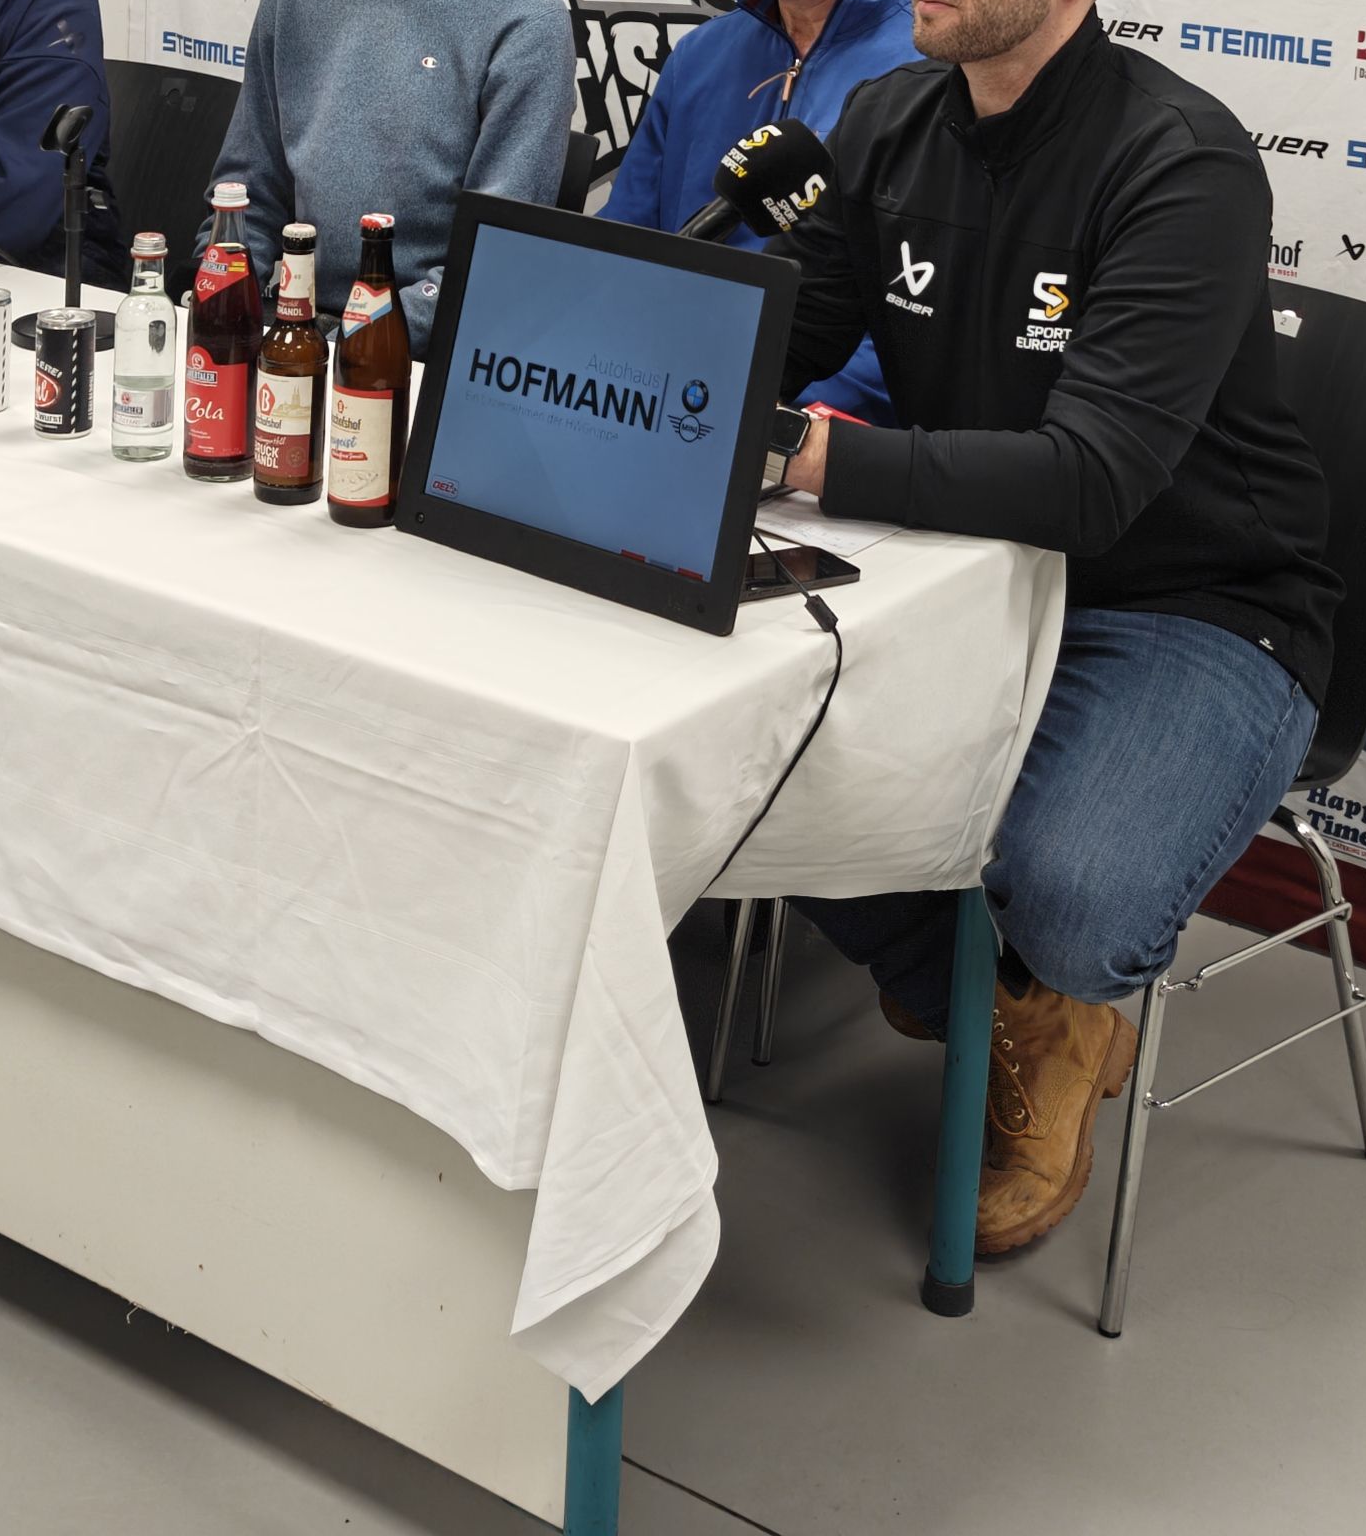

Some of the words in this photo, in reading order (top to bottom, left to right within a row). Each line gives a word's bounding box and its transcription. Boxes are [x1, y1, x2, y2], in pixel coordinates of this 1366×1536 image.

[163, 31, 246, 65] STEMMLE
[1181, 23, 1332, 67] STEMMLE
[197, 279, 216, 292] Cola
[1027, 325, 1072, 340] SPORT
[587, 354, 661, 388] Autohaus
[469, 348, 657, 431] HOFMANN
[185, 397, 224, 423] Cola
